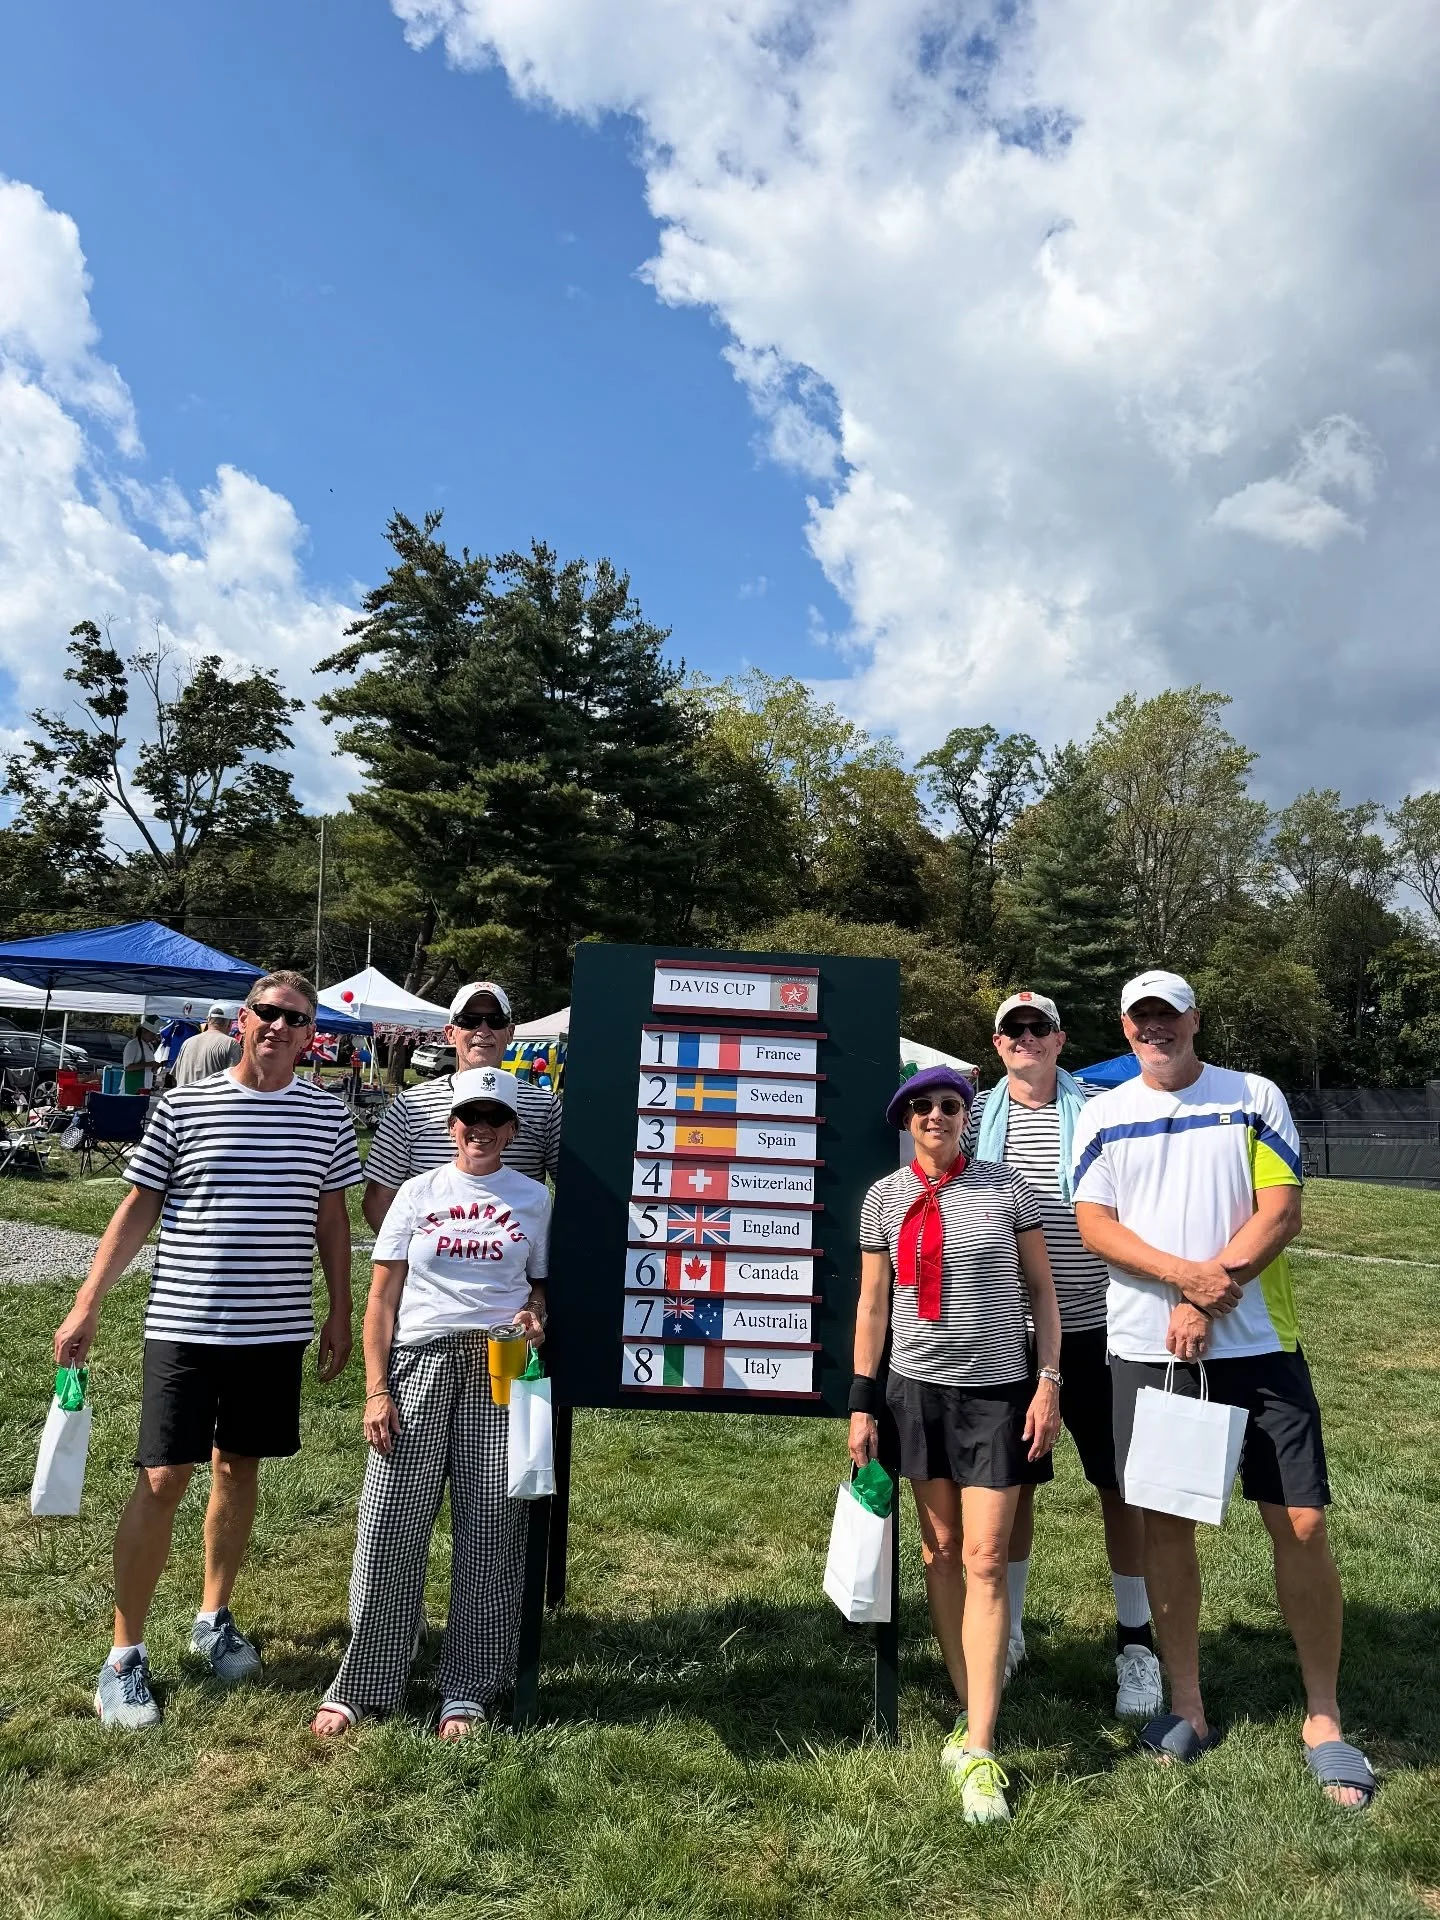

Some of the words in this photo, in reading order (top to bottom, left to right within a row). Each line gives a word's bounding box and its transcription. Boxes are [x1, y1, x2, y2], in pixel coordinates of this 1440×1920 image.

[670, 979, 719, 994] DAVIS
[724, 982, 756, 996] CUP
[654, 1034, 666, 1064] 1
[755, 1046, 801, 1061] France
[647, 1076, 667, 1106] 2
[750, 1089, 803, 1104] Sweden
[646, 1119, 665, 1150] 3
[758, 1132, 796, 1148] Spain
[641, 1162, 663, 1194] 4
[731, 1175, 813, 1192] Switzerland
[417, 1213, 444, 1234] LE
[449, 1203, 527, 1242] MARAIS
[639, 1205, 658, 1239] 5
[743, 1219, 800, 1237] England
[436, 1236, 503, 1260] PARIS
[636, 1253, 657, 1287] 6
[738, 1264, 799, 1281] Canada
[634, 1300, 655, 1334] 7
[733, 1312, 808, 1330] Australia
[633, 1347, 653, 1383] 8
[744, 1358, 781, 1379] Italy
